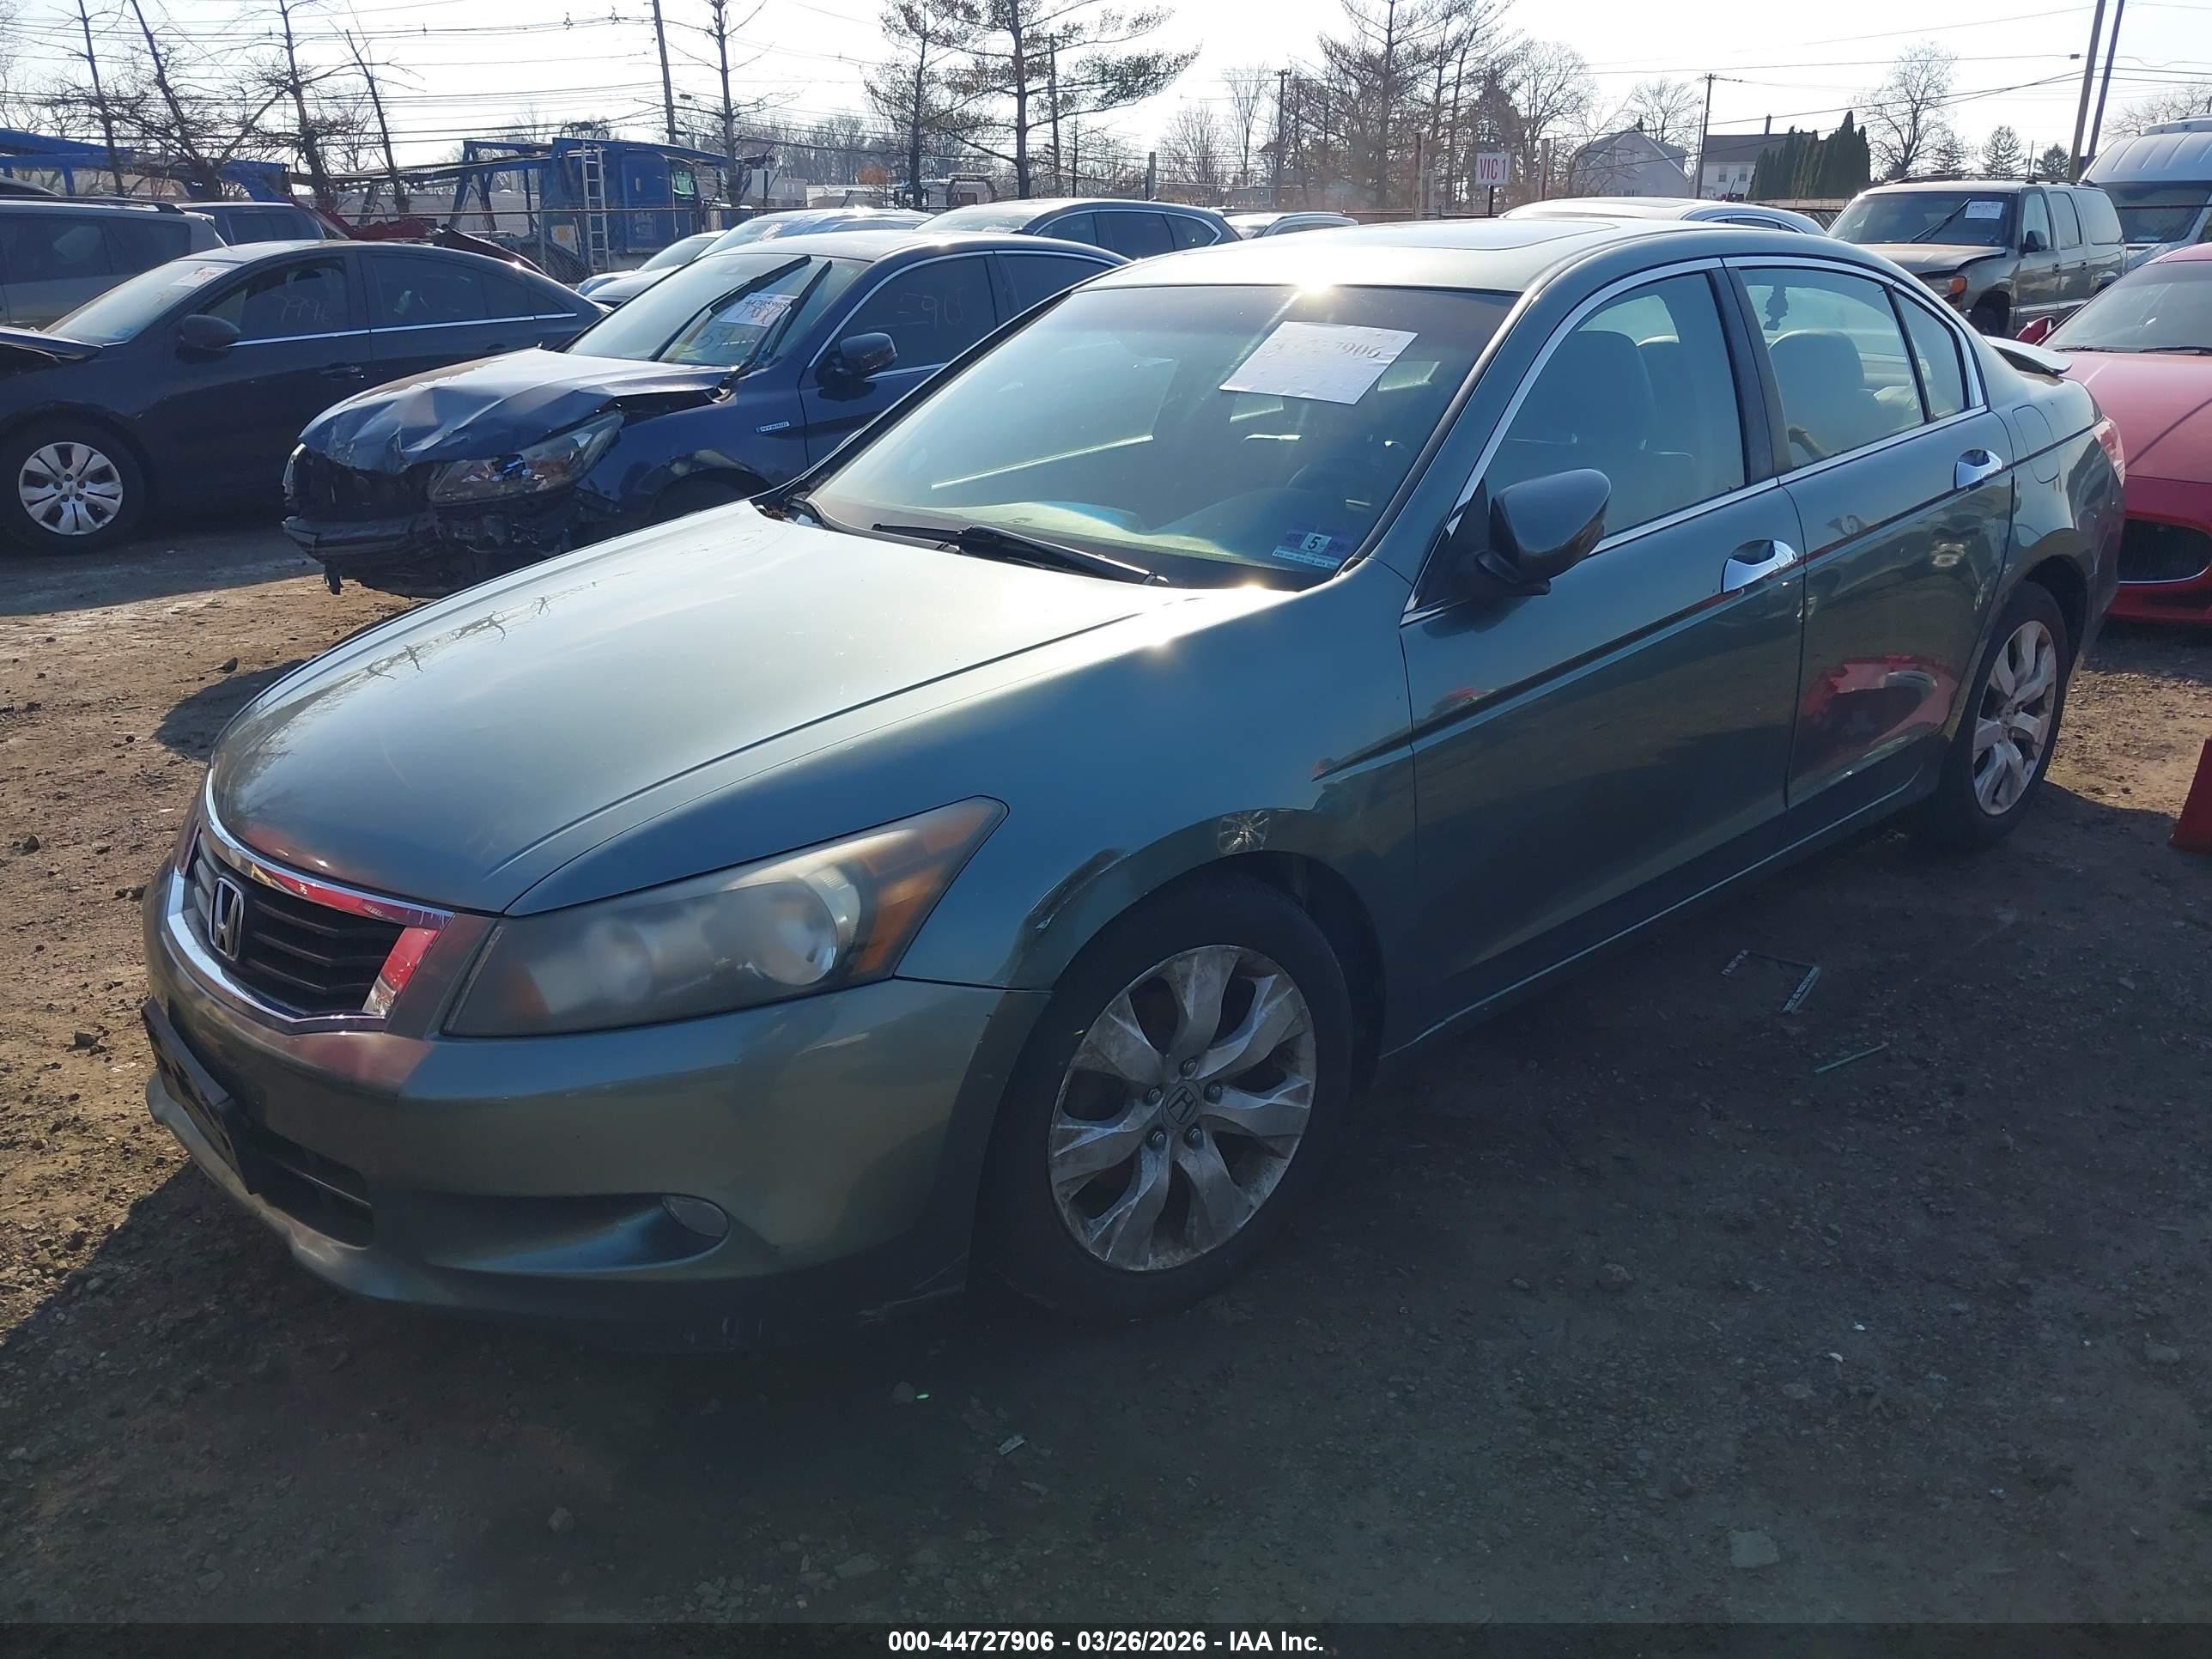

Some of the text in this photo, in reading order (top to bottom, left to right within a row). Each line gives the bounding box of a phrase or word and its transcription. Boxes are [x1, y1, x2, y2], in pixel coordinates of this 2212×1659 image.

[1480, 158, 1507, 180] VIC 1
[1308, 535, 1322, 550] 5
